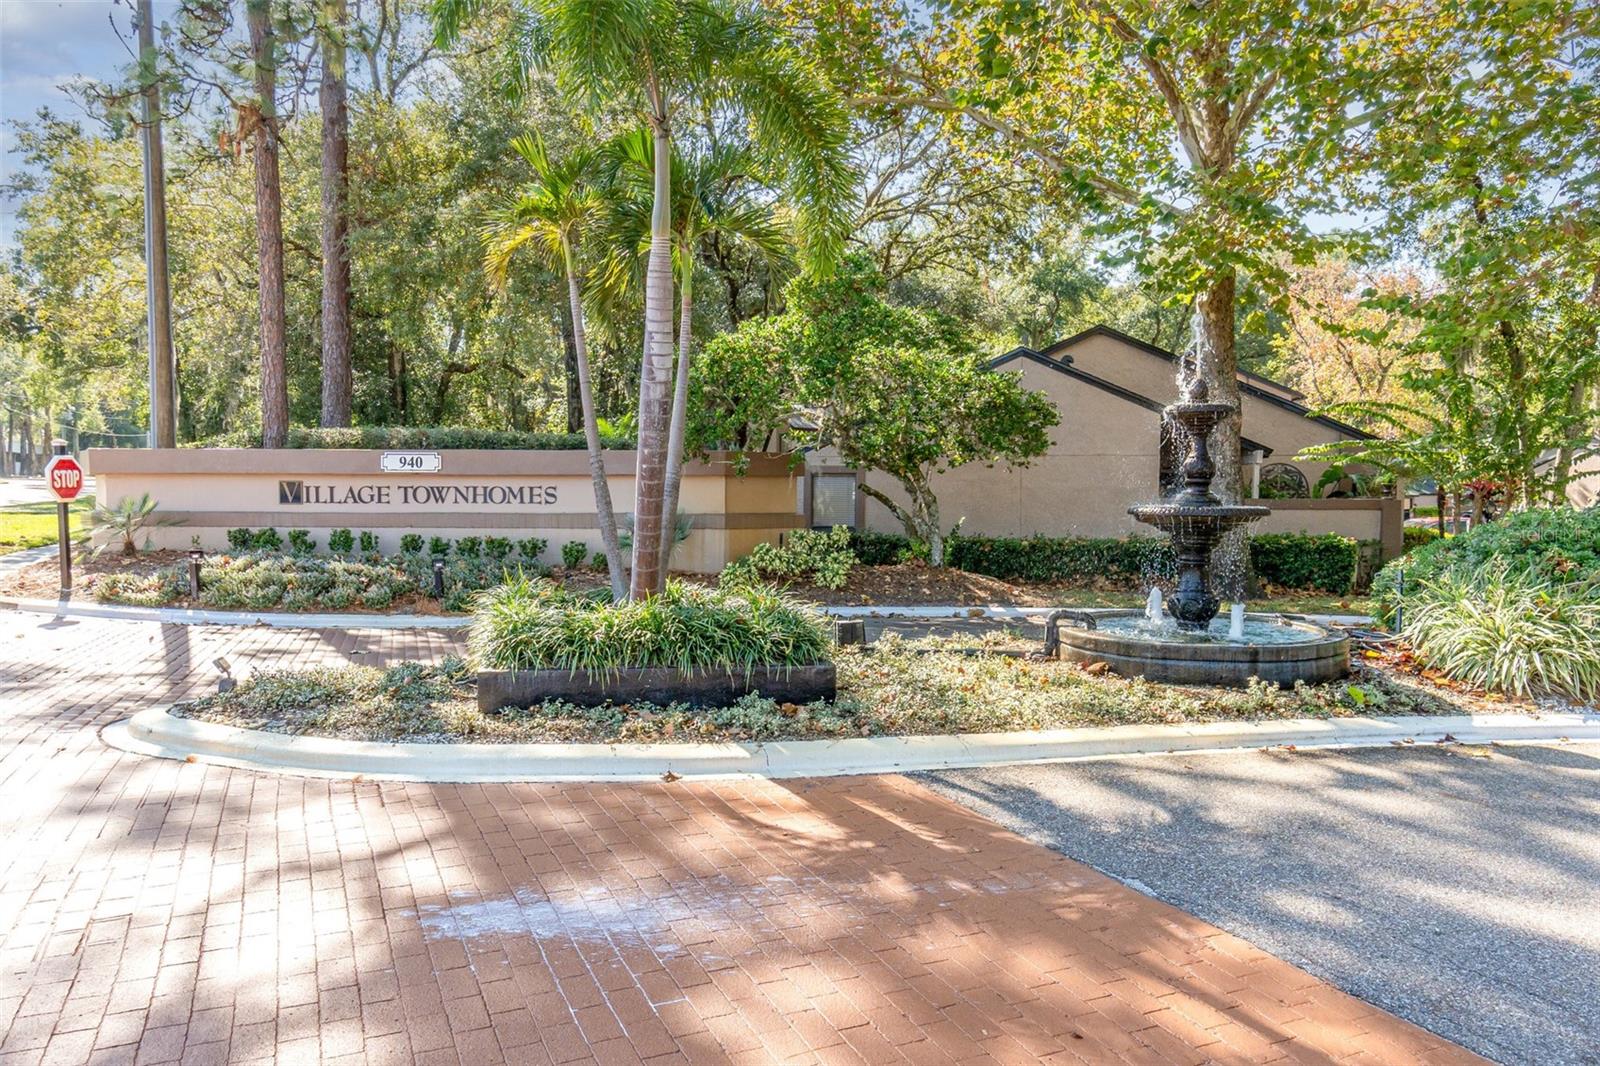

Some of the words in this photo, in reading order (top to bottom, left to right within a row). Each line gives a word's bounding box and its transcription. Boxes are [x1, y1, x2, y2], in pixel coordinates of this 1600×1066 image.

[399, 456, 423, 469] 940
[53, 469, 80, 489] STOP
[279, 480, 391, 505] VILLAGE
[397, 485, 558, 505] TOWNHOMES
